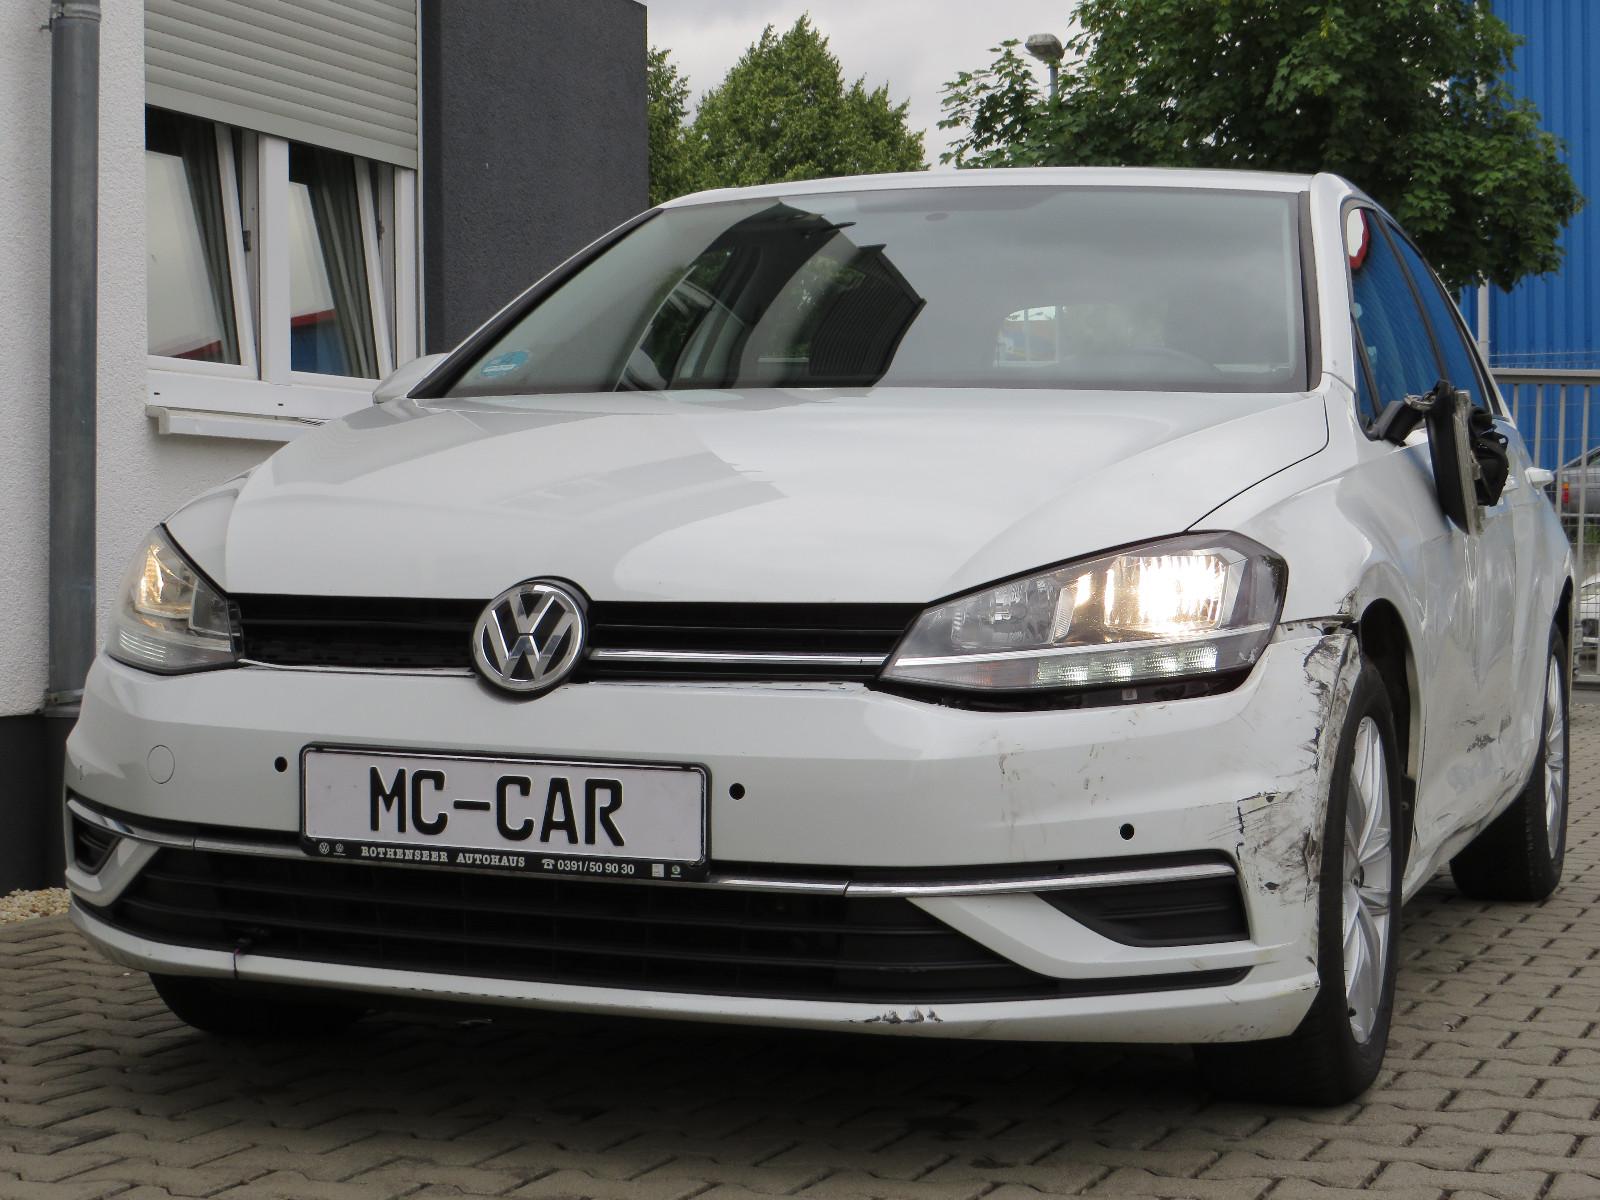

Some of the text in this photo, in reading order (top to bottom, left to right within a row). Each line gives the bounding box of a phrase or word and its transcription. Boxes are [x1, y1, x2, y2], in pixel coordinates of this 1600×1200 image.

[369, 765, 625, 847] MC-CAR
[360, 846, 449, 863] ROTHENSEER
[456, 853, 526, 868] AUTOHAUS
[557, 860, 603, 873] 0391/50
[605, 863, 619, 874] 90
[621, 863, 635, 875] 30
